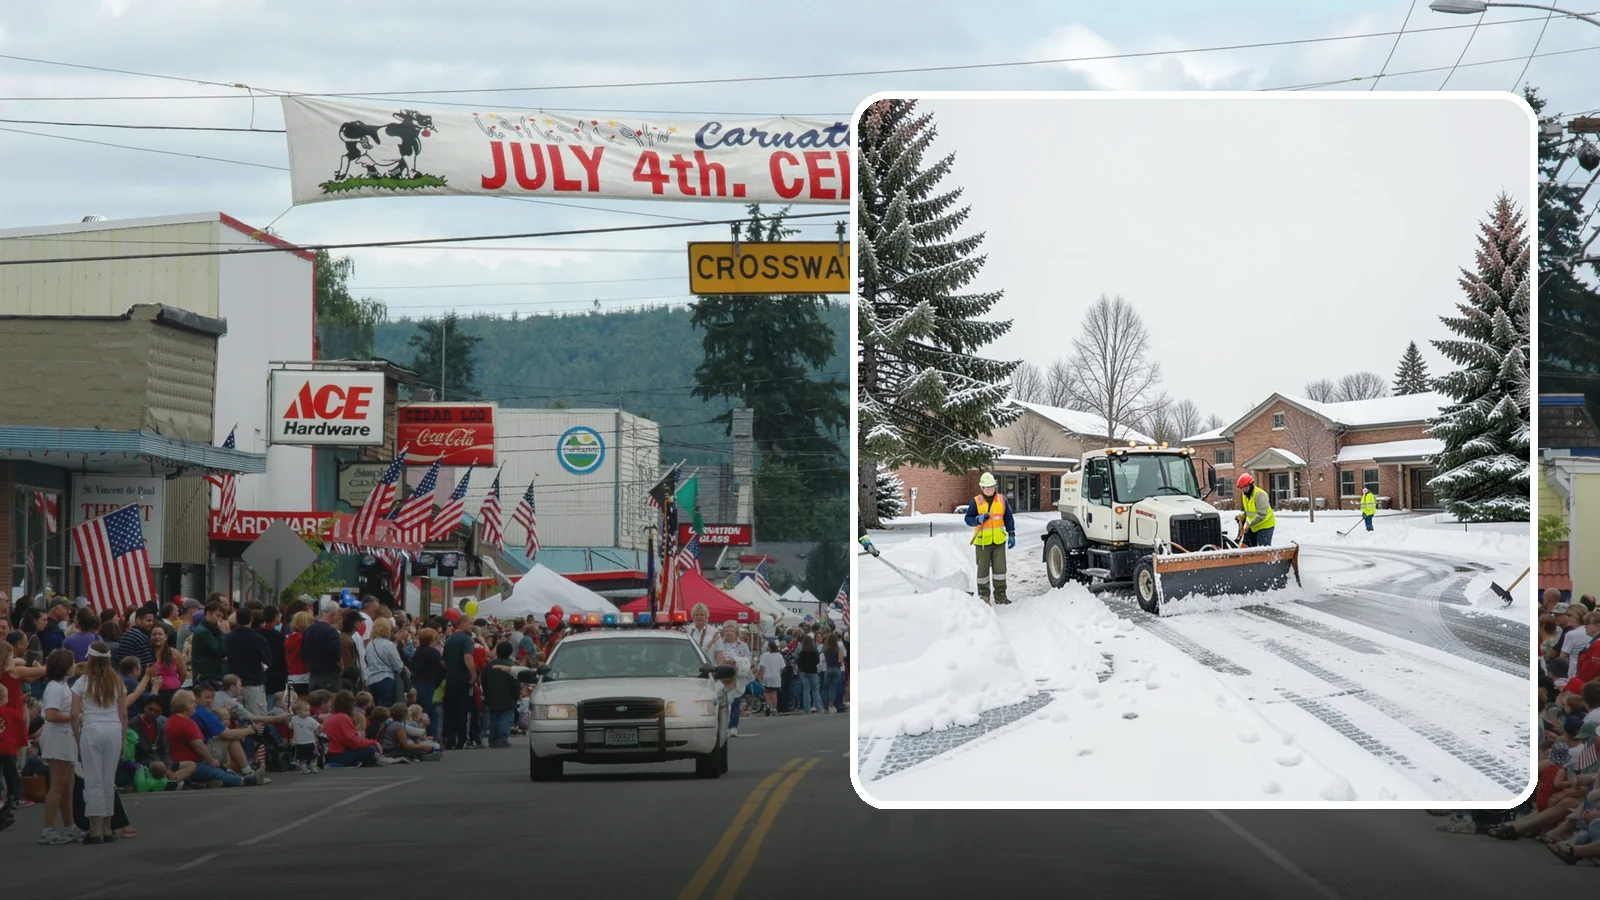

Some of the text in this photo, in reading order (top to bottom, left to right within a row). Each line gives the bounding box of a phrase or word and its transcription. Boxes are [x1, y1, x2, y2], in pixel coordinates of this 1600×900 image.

[481, 141, 605, 192] JULY
[632, 150, 747, 197] 4th.
[696, 254, 850, 280] CROSSWA
[283, 380, 373, 419] ACE
[405, 409, 452, 422] CEDAR
[283, 421, 371, 436] Hardware
[416, 428, 477, 447] Coca-Cola
[353, 467, 384, 480] Simpl
[83, 485, 155, 495] St. Vincent de Paul
[81, 504, 153, 521] THRT
[213, 516, 331, 535] HARDARE
[688, 526, 741, 535] CRNATION
[699, 535, 730, 543] GLASS
